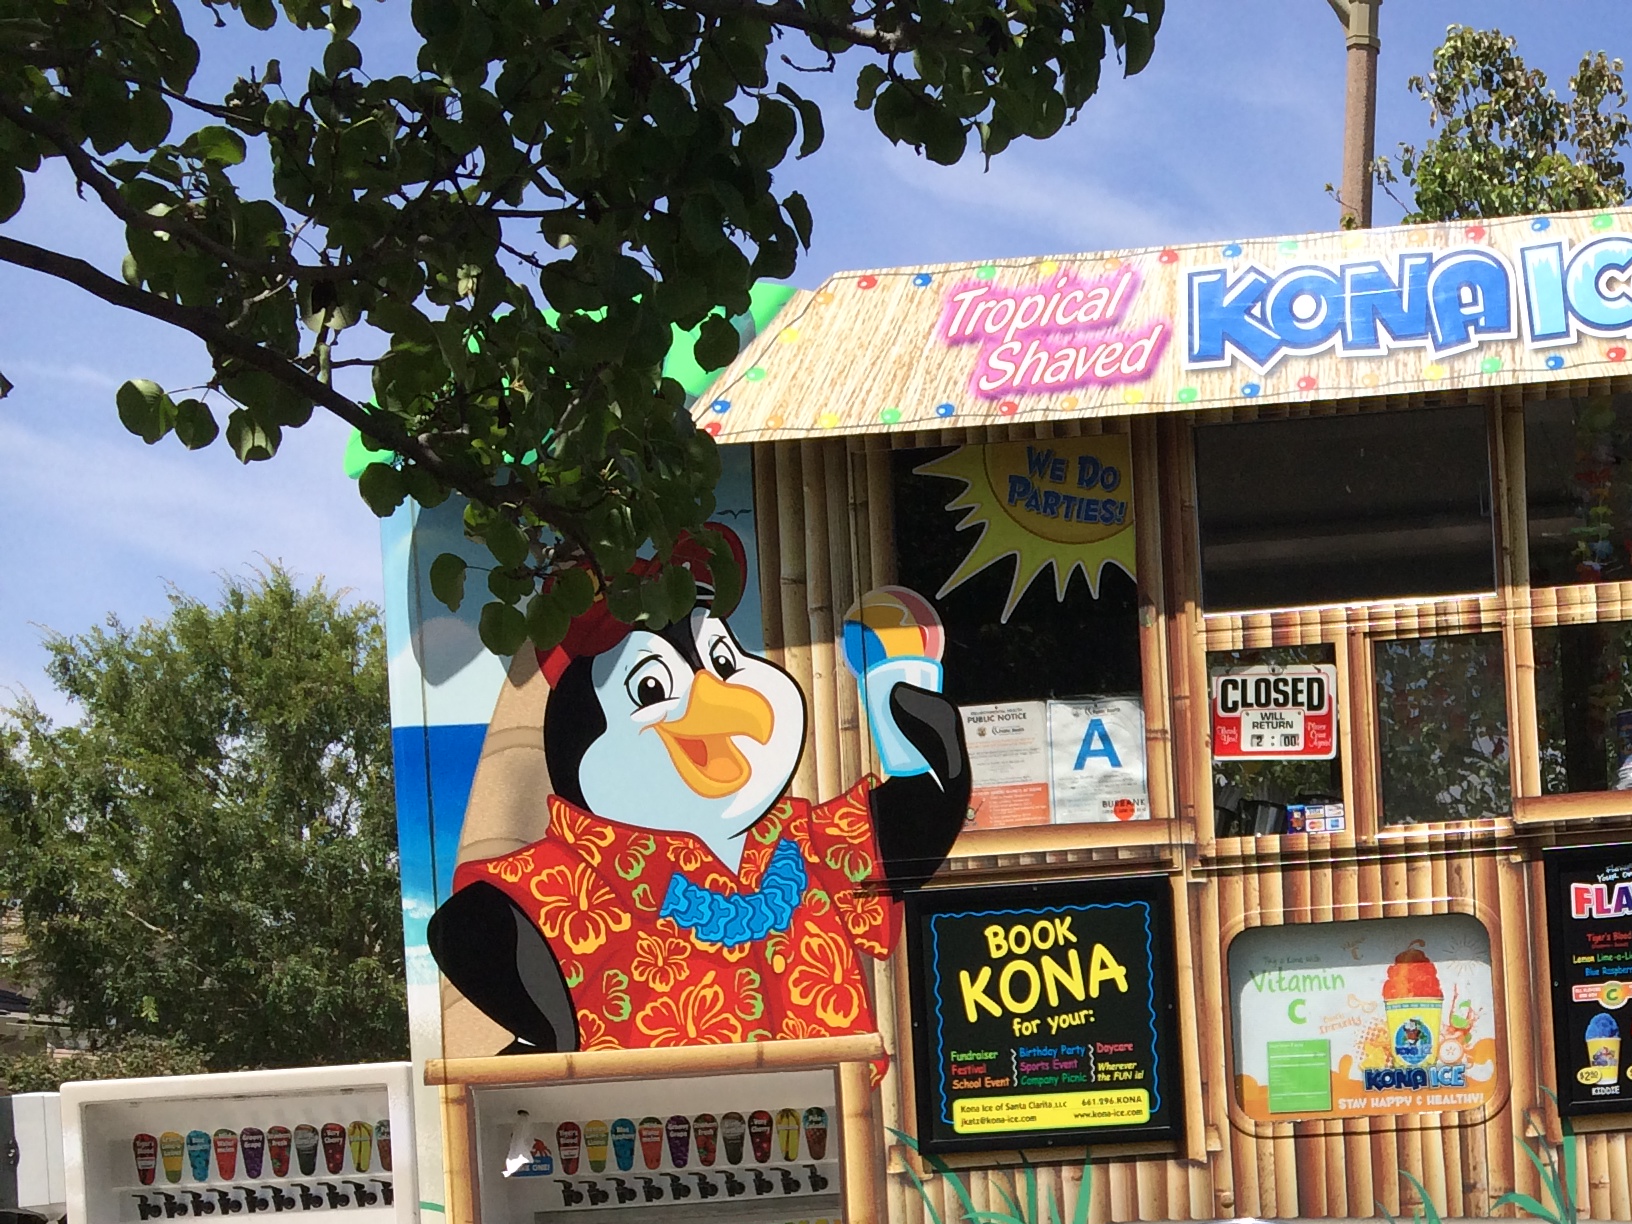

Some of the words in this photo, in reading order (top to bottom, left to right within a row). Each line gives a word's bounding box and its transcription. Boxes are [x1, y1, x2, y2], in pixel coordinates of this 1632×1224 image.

[947, 271, 1134, 344] Tropical
[1184, 246, 1516, 372] KONA
[977, 324, 1165, 392] Shaved
[1007, 474, 1127, 525] PARTIES!
[1220, 677, 1325, 713] CLOSED
[967, 714, 995, 723] PUBLIC
[997, 712, 1027, 721] NOTICE
[1260, 712, 1286, 721] WILL
[1252, 720, 1294, 730] RETURN
[1073, 718, 1123, 771] A
[984, 916, 1077, 959] BOOK
[1572, 954, 1596, 964] Lemon
[1585, 966, 1600, 976] Blue
[959, 943, 1129, 1023] KONA
[1248, 966, 1346, 993] Vitamin
[1606, 988, 1618, 1001] C
[1287, 998, 1307, 1025] C
[1012, 1018, 1042, 1037] for
[1047, 1009, 1096, 1035] your:
[950, 1050, 999, 1062] Fundraiser
[1018, 1046, 1058, 1059] Birthday
[1060, 1044, 1086, 1057] Party
[1095, 1042, 1134, 1055] Daycare
[950, 1063, 987, 1076] Festival
[1019, 1061, 1050, 1074] Sports
[1052, 1058, 1078, 1070] Event
[1097, 1061, 1137, 1071] Wherever
[952, 1078, 982, 1090] School
[984, 1076, 1011, 1088] Event
[1020, 1075, 1059, 1088] Company
[1062, 1072, 1088, 1083] Picnic
[1097, 1072, 1111, 1082] the
[1112, 1070, 1133, 1081] FUN
[1364, 1067, 1428, 1091] KONA
[1429, 1064, 1466, 1088] ICE
[1591, 1085, 1620, 1096] KIDDIE
[960, 1105, 980, 1113] Kona
[981, 1104, 993, 1112] Ice
[995, 1103, 1004, 1111] of
[1005, 1102, 1027, 1110] Santa
[1338, 1098, 1367, 1109] STAY
[1371, 1096, 1412, 1108] HAPPY
[1427, 1093, 1484, 1105] HEALTHY!
